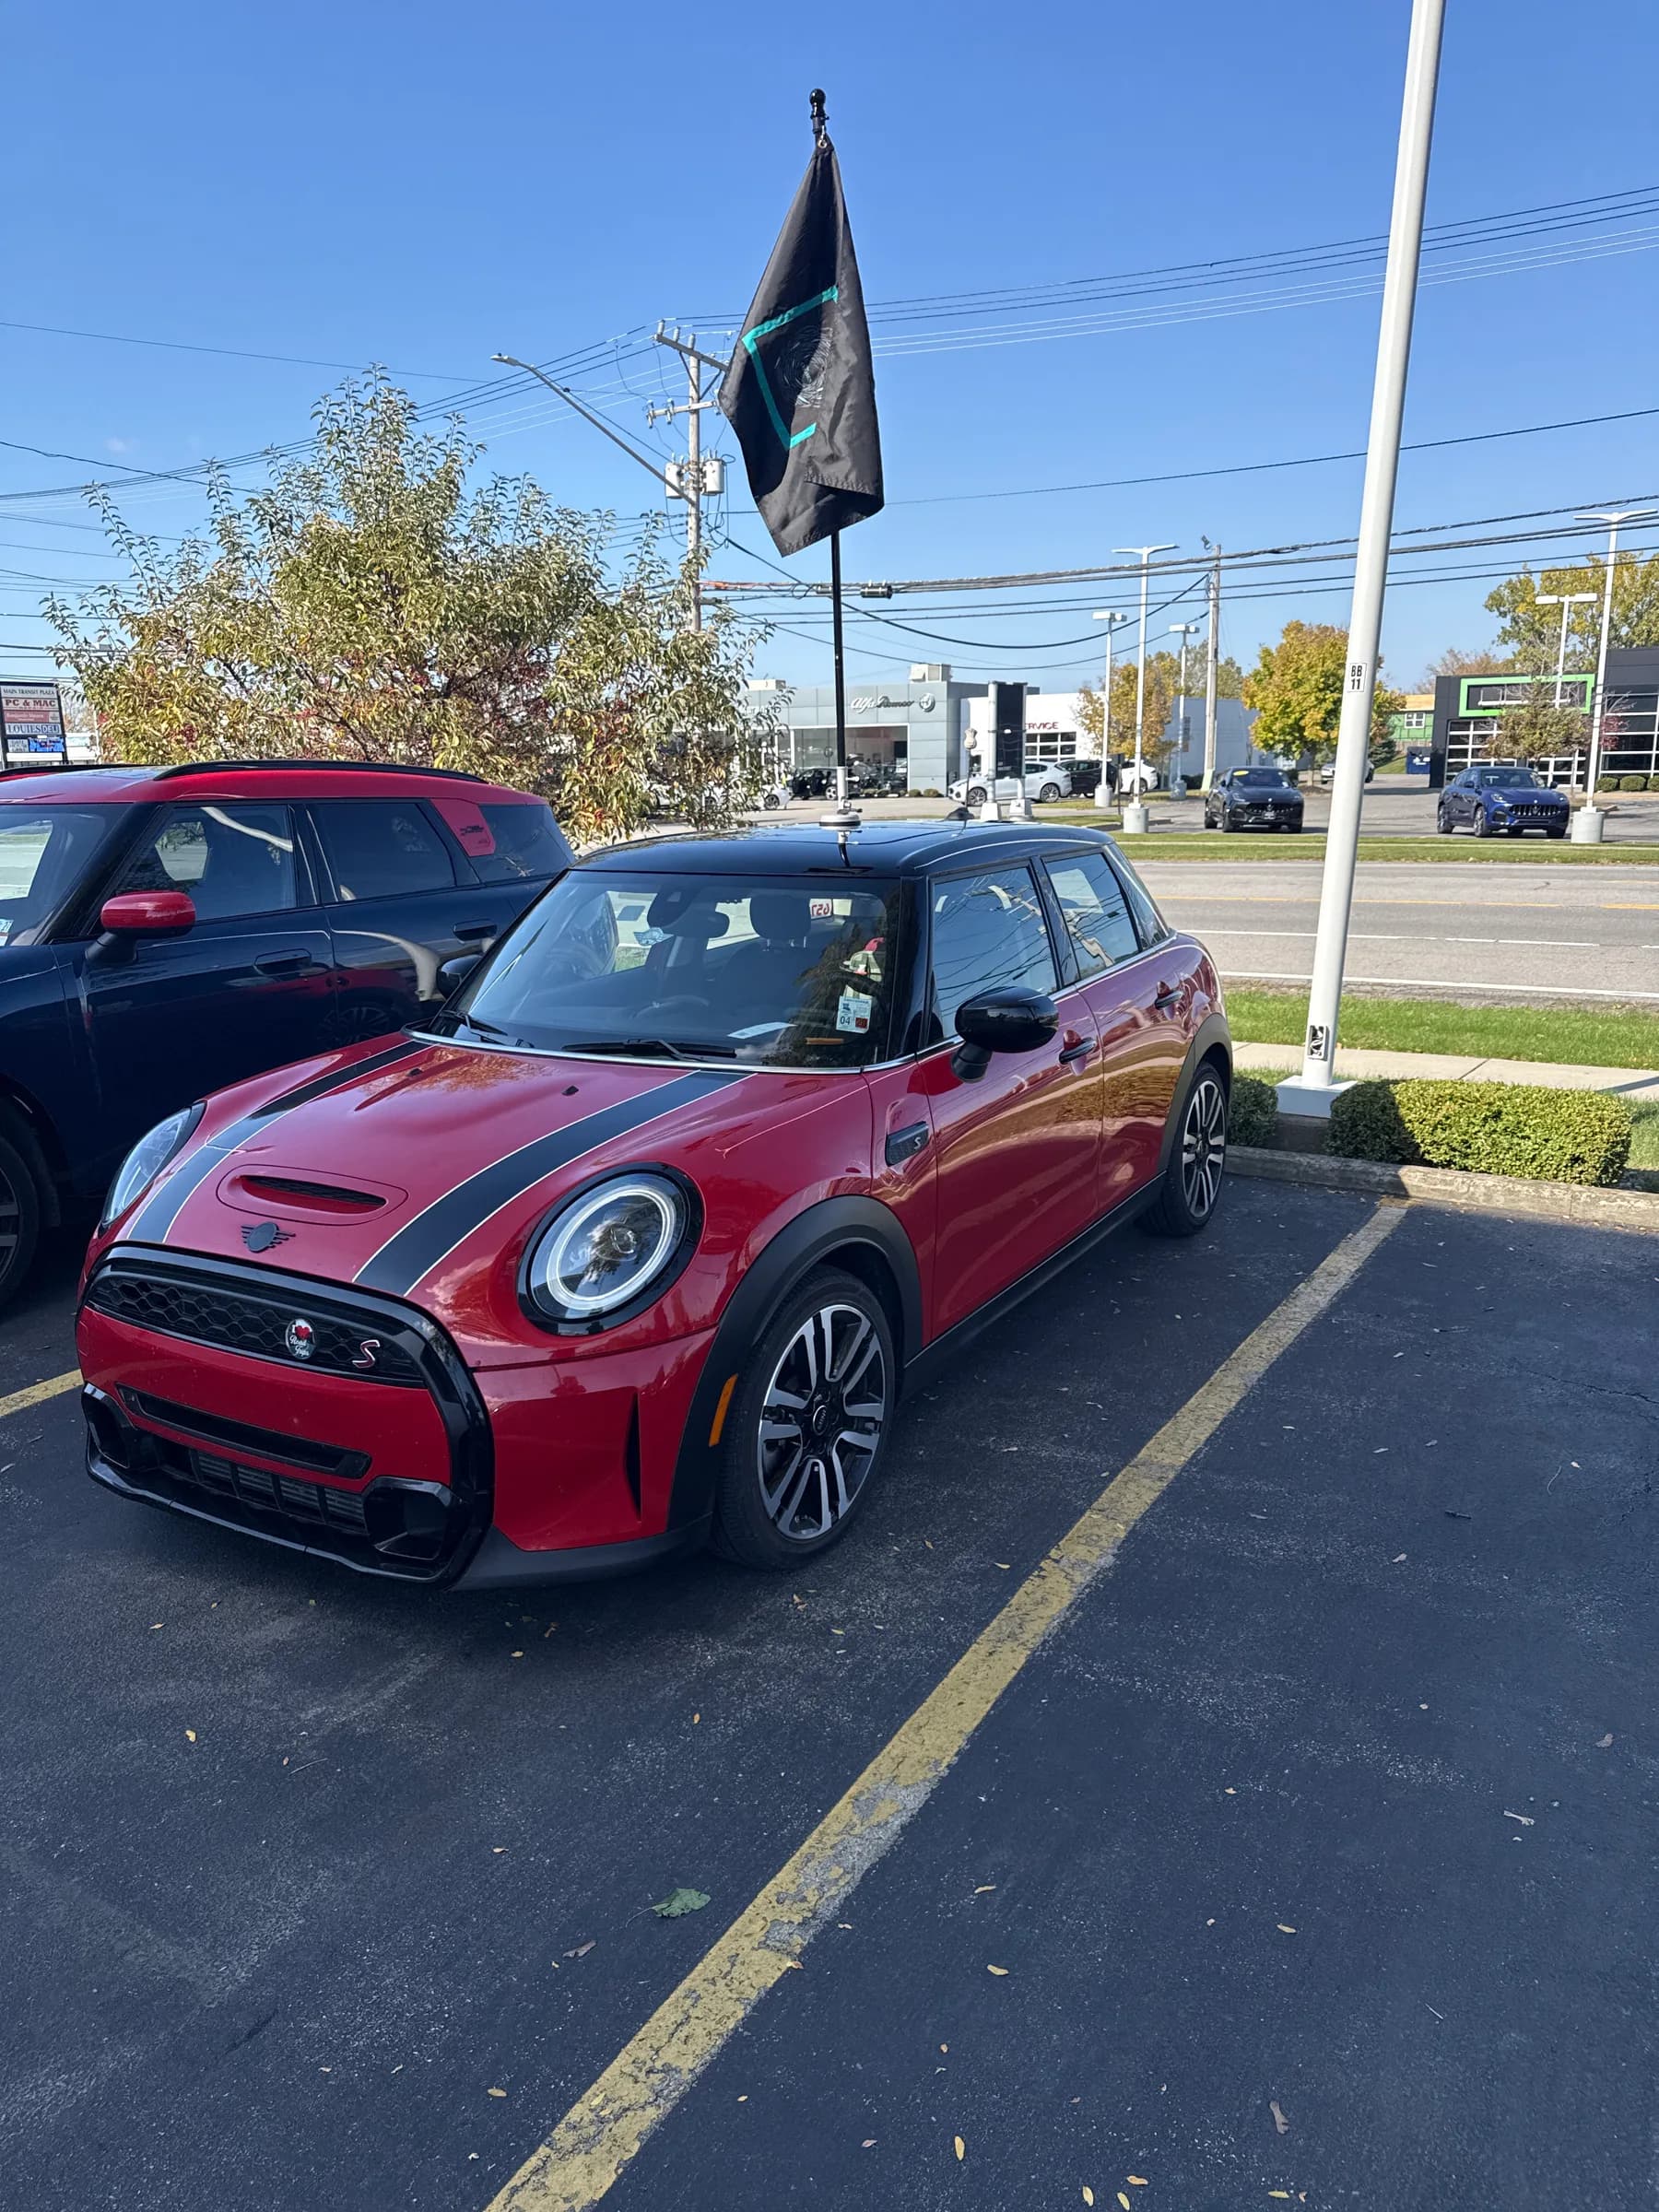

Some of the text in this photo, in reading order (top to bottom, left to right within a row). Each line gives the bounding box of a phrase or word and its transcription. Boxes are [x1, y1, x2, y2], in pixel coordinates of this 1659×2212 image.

[1350, 677, 1361, 690] 11
[5, 699, 19, 707] PC
[851, 697, 877, 714] Alfa
[840, 1016, 851, 1026] 04
[913, 1136, 922, 1150] S
[291, 1324, 296, 1334] I
[289, 1335, 307, 1347] Road
[294, 1345, 310, 1358] Trips
[352, 1339, 381, 1369] S
